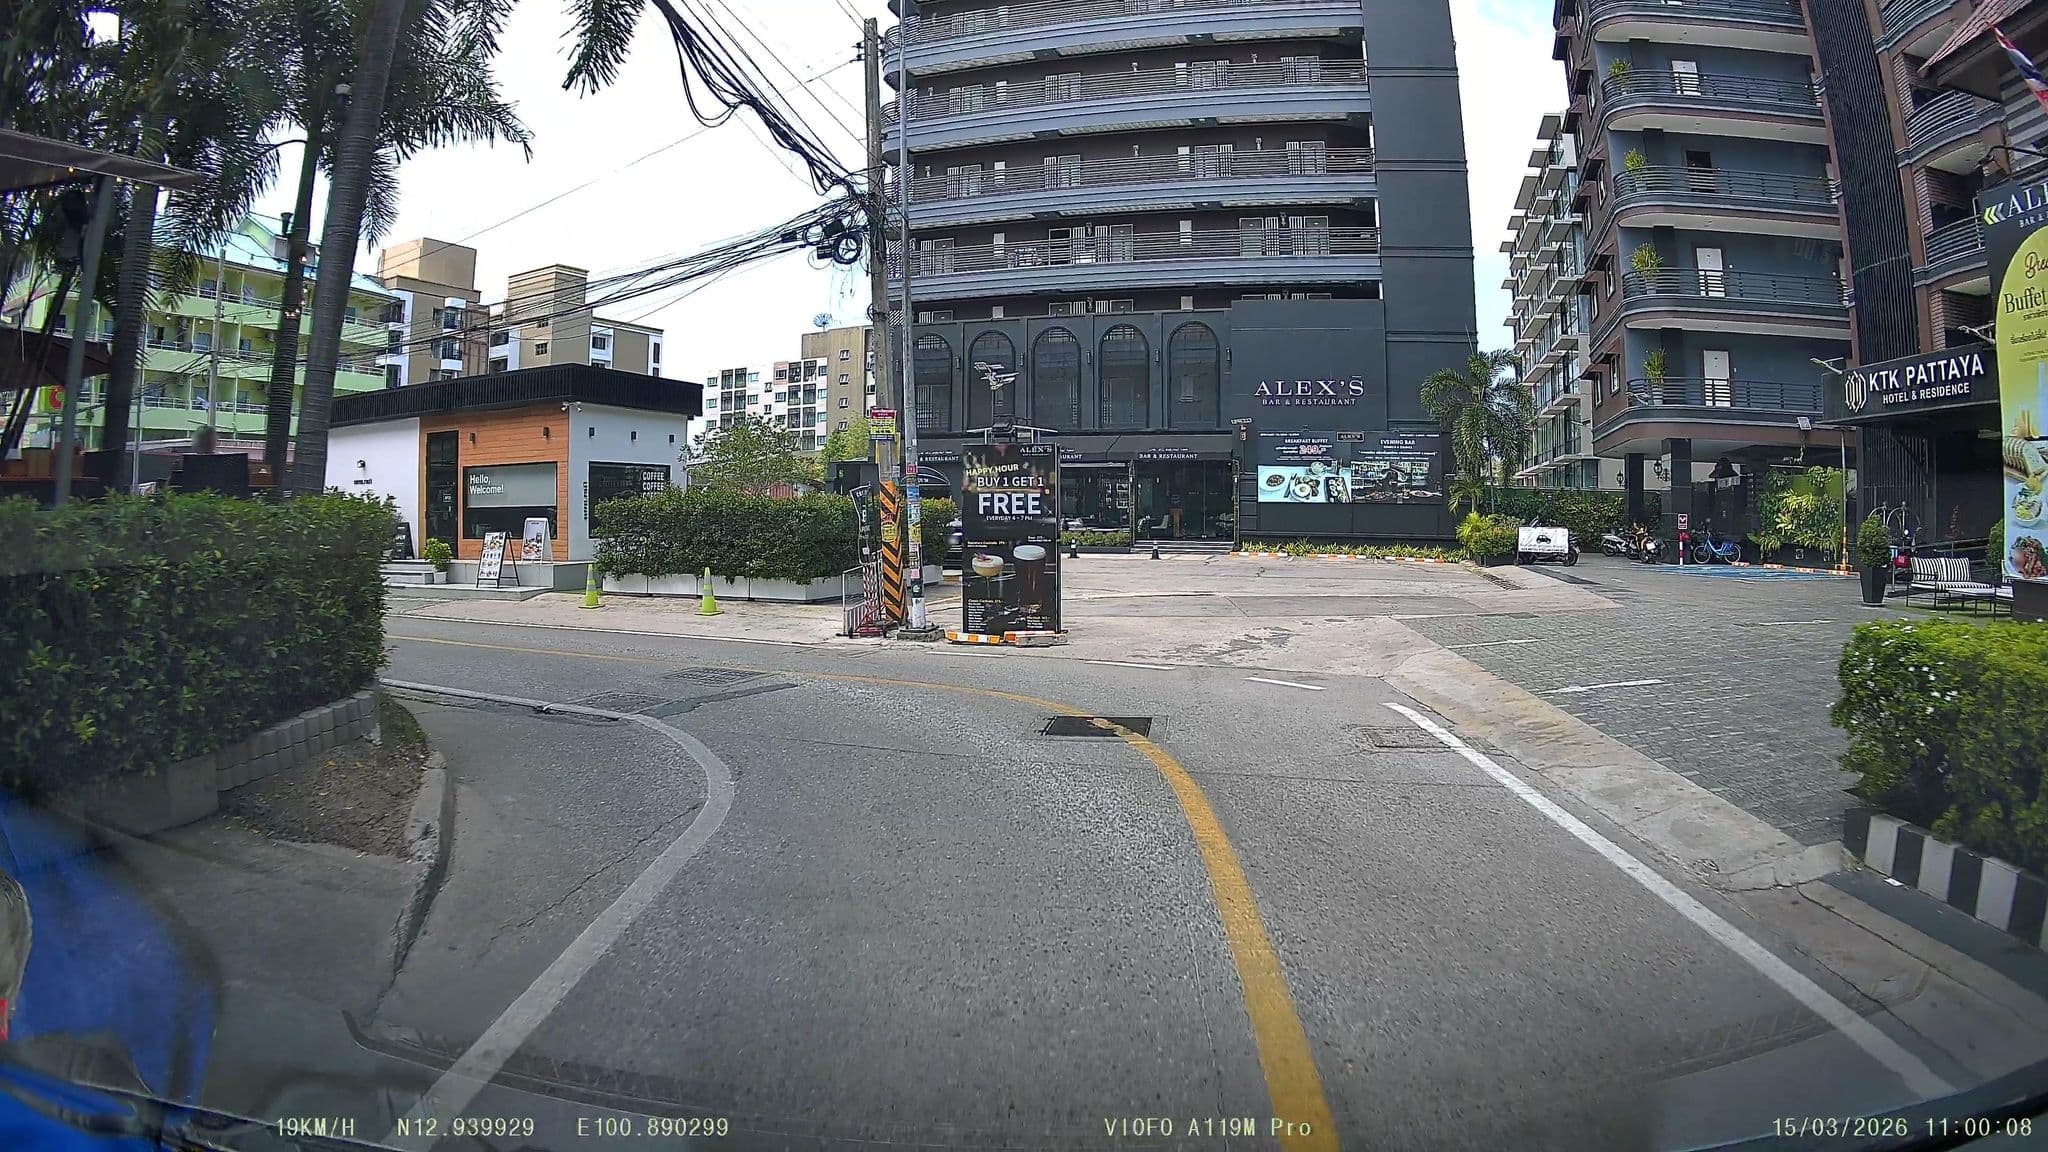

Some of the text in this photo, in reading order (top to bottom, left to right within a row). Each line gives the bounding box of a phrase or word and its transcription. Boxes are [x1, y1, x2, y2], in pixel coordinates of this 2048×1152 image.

[2004, 286, 2048, 314] Buffet
[1869, 368, 1900, 392] KTK
[1906, 353, 1984, 387] PATTAYA
[1883, 382, 1970, 405] HOTEL & RESIDENCE
[1295, 398, 1356, 406] RESTAURANT
[966, 463, 1019, 476] HAPPY HOUR
[470, 474, 491, 485] Hello,
[642, 471, 665, 481] COFFEE
[977, 476, 1044, 487] BUY 1 GET 1
[470, 483, 504, 495] Welcome!
[642, 481, 664, 491] COFFEE
[978, 493, 1041, 515] FREE
